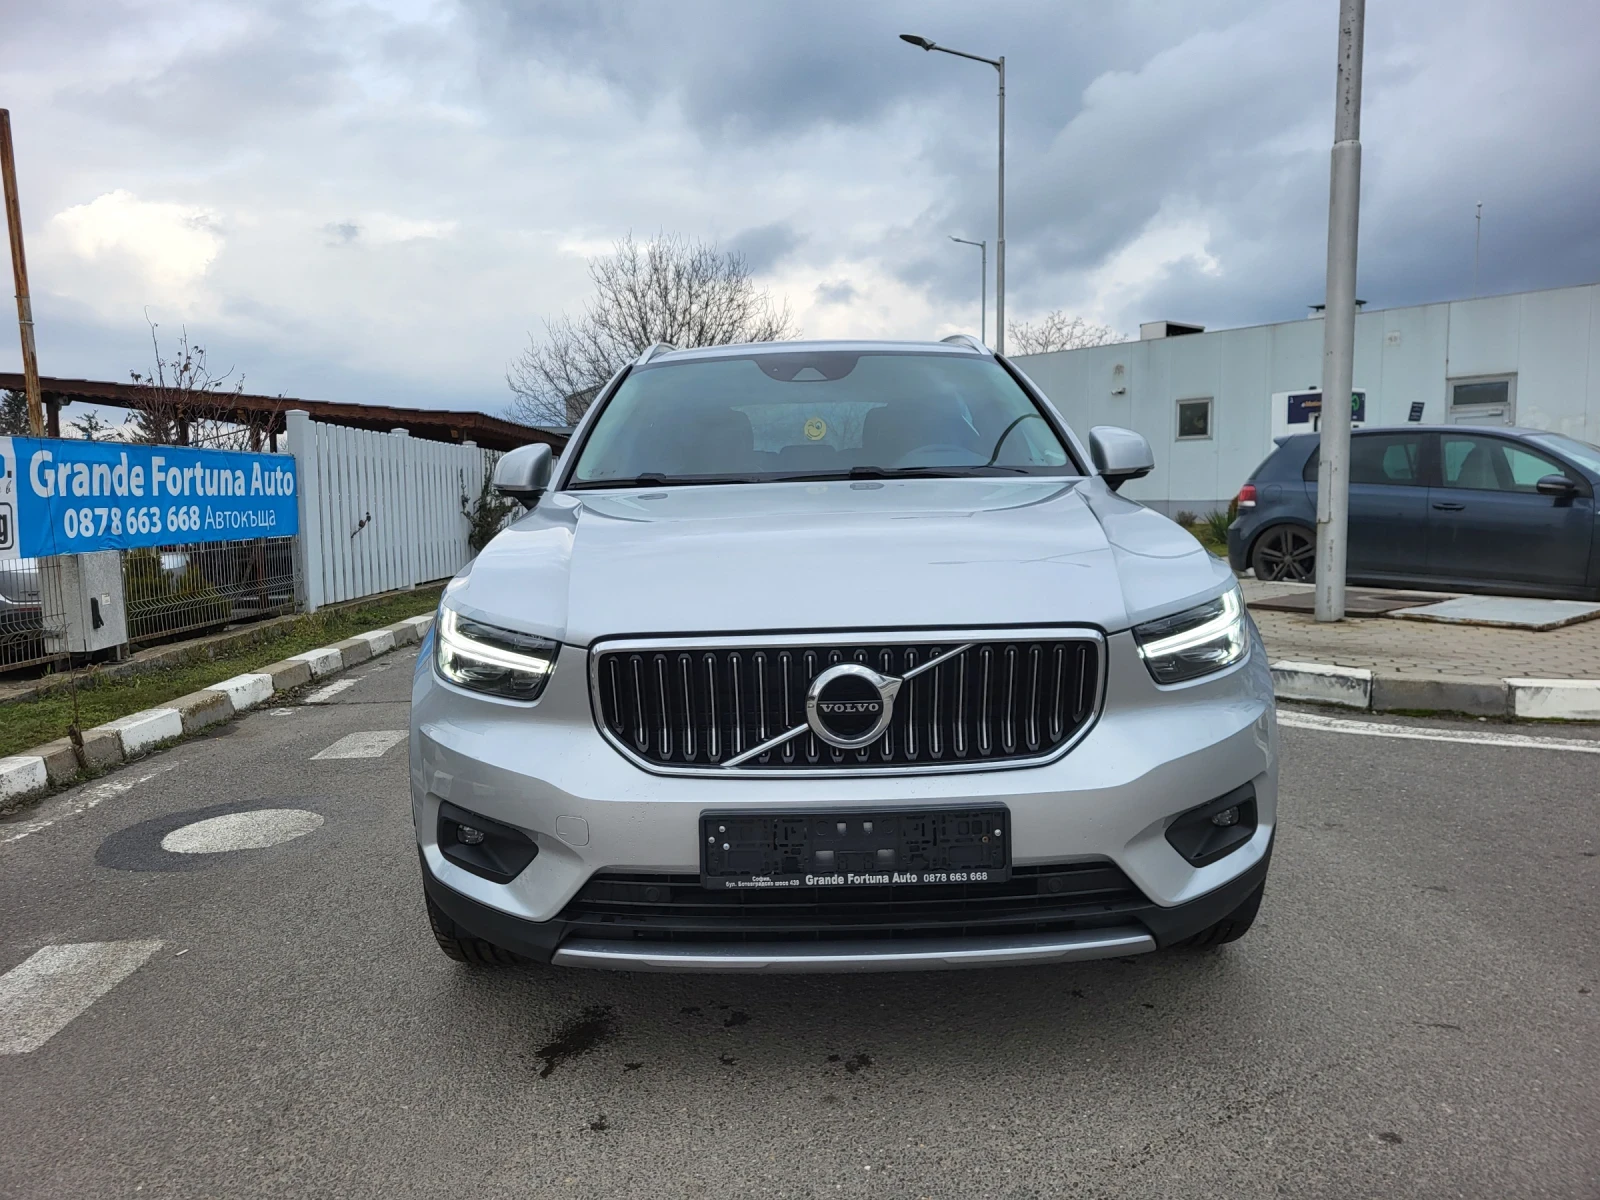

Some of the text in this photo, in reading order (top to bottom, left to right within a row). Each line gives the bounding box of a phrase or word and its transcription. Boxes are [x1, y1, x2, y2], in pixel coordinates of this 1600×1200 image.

[29, 449, 294, 498] Grande Fortuna Auto
[63, 504, 276, 539] 0878 663 668 Автокъща
[820, 703, 879, 713] VOLVO
[805, 872, 988, 886] Grande Fortuna Auto 0878 663 668
